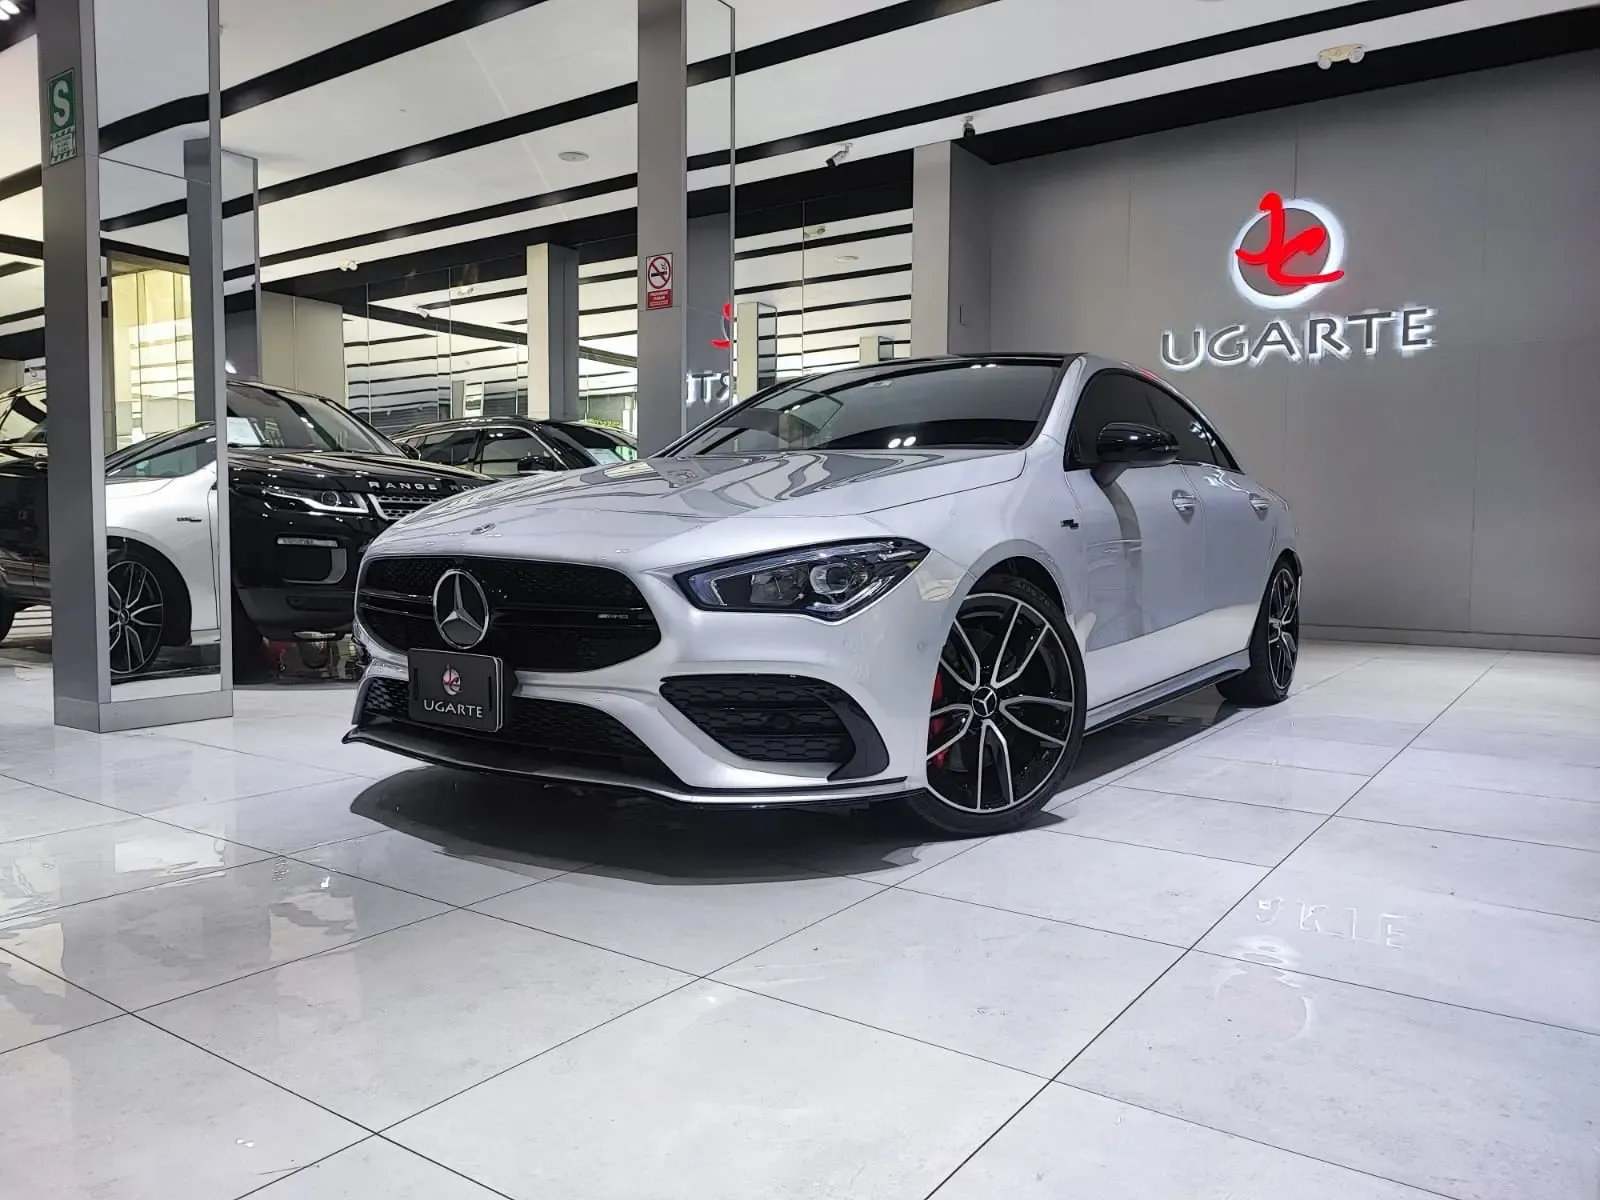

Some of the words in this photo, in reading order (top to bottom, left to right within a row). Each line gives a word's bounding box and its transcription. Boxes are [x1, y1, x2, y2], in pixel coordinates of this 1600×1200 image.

[53, 80, 70, 127] S
[1161, 308, 1430, 369] UGARTE
[368, 481, 437, 490] RANGE
[423, 699, 483, 718] UGARTE
